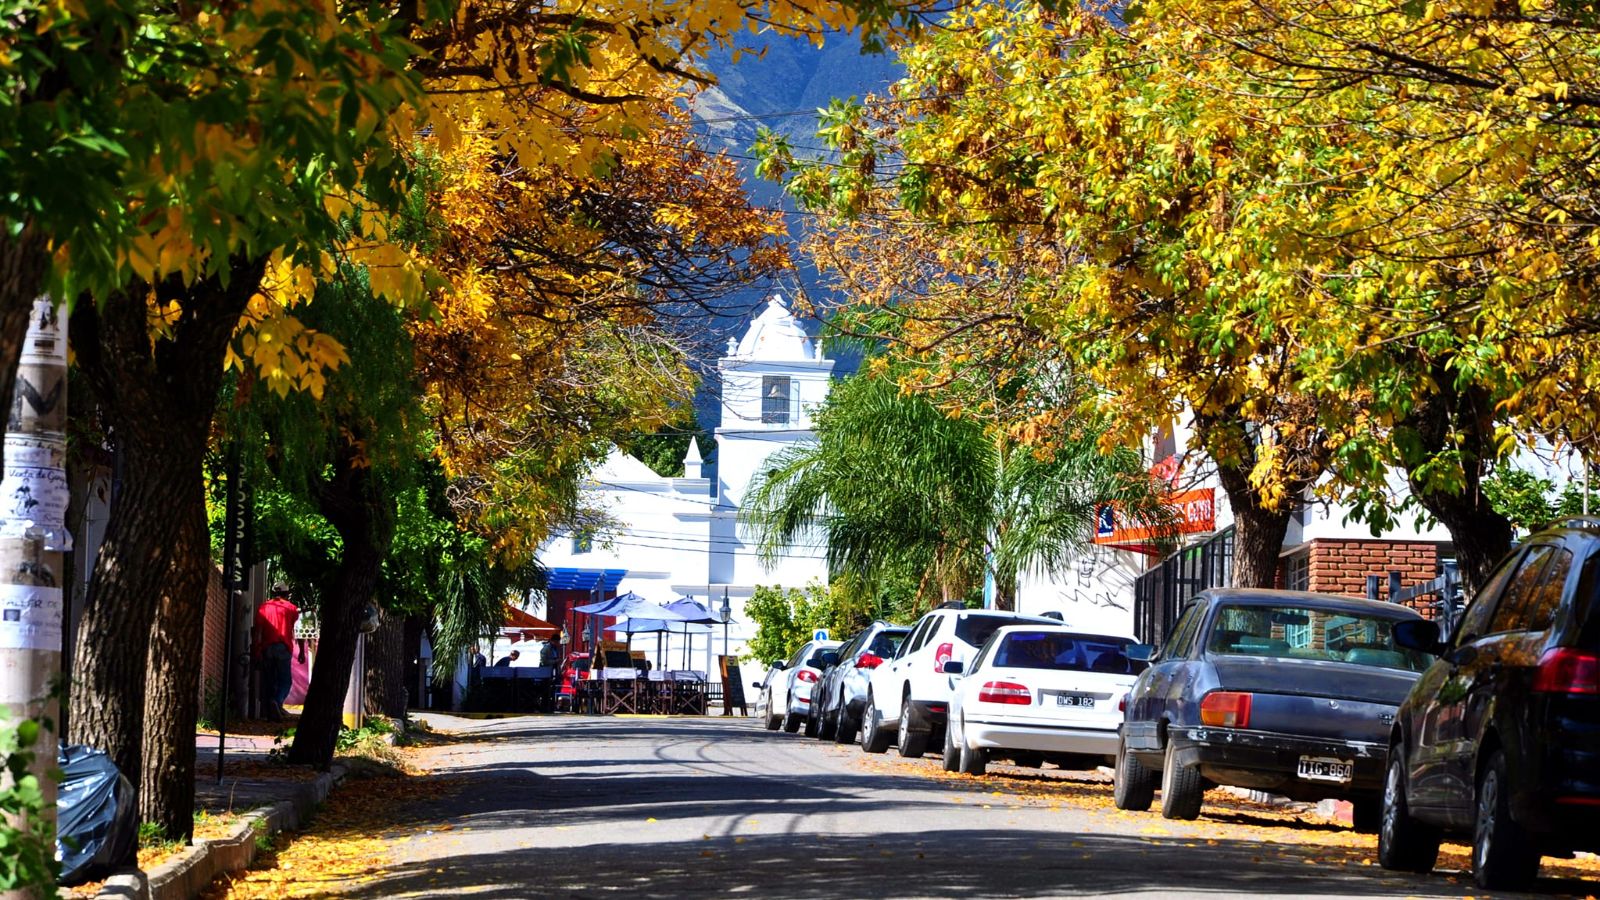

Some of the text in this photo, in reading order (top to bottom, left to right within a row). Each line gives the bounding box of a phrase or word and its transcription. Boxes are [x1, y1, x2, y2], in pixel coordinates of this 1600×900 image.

[1058, 696, 1093, 707] DWS 182
[1329, 764, 1351, 778] 864
